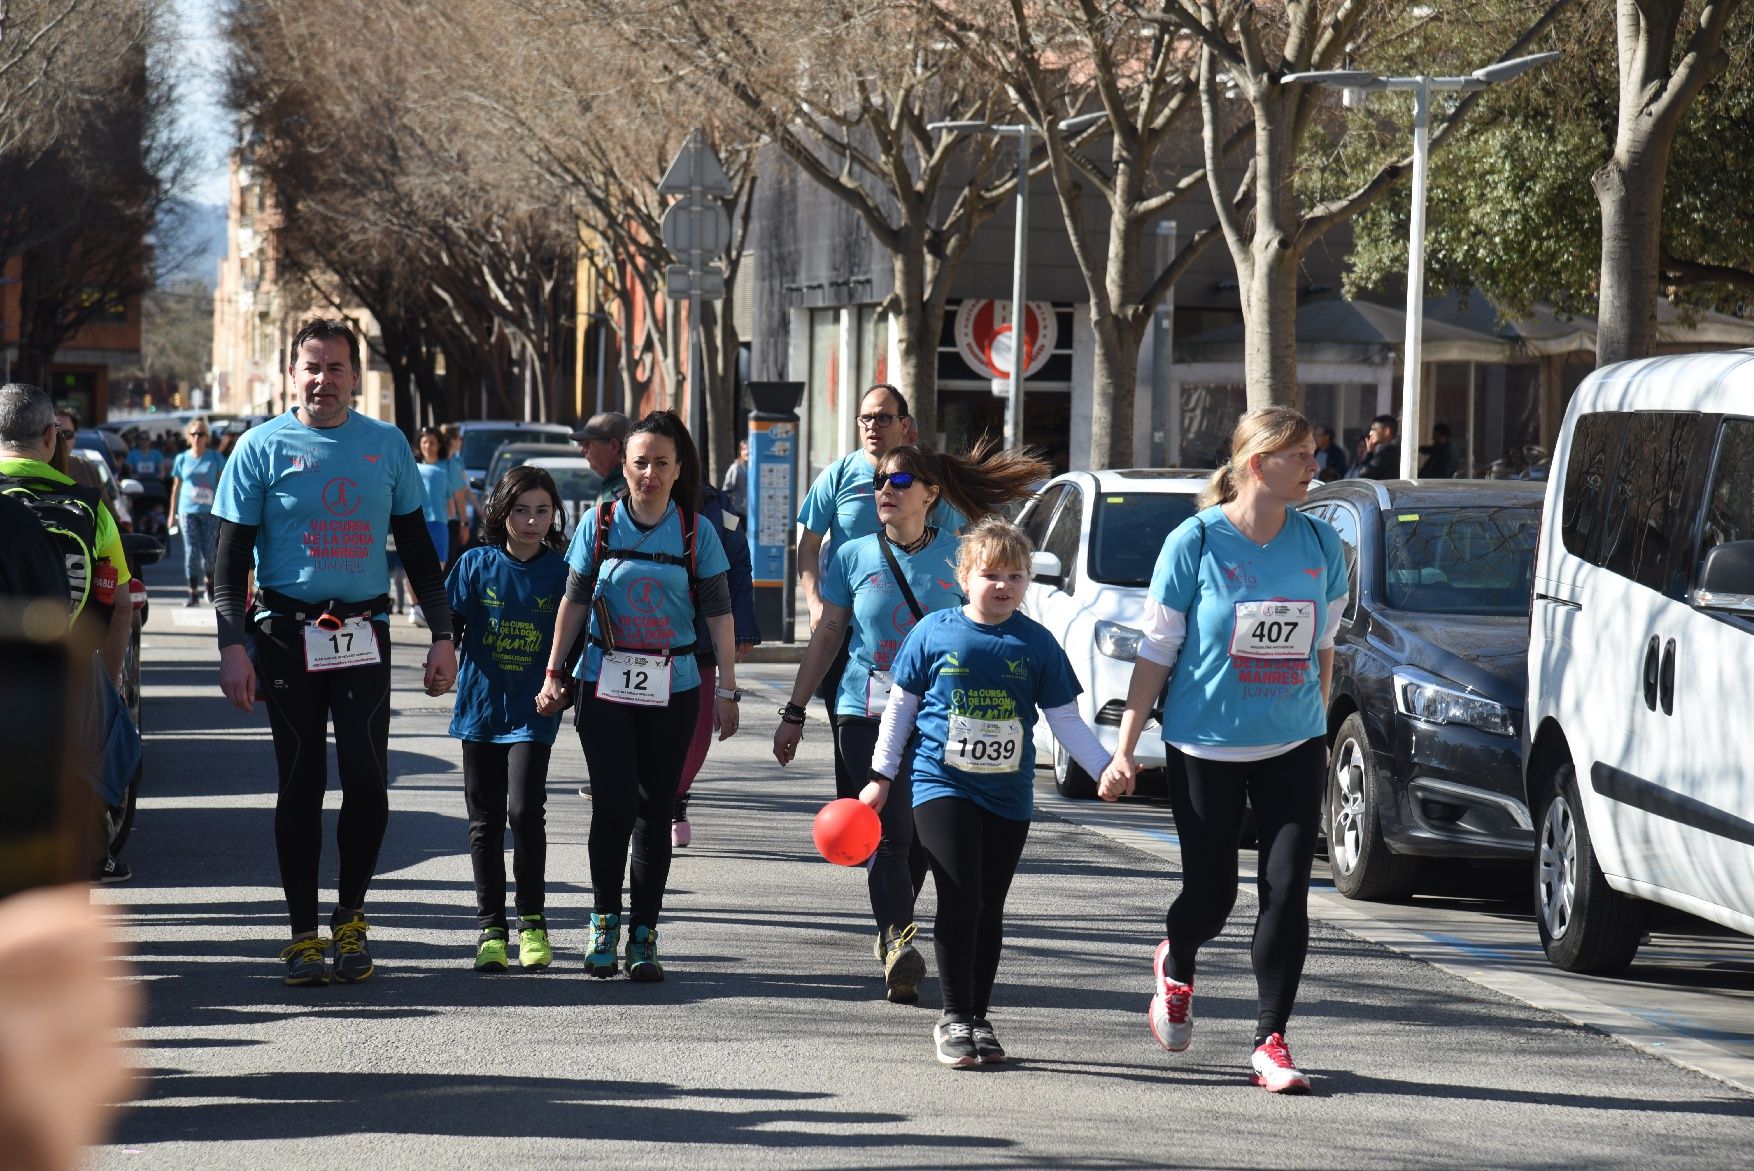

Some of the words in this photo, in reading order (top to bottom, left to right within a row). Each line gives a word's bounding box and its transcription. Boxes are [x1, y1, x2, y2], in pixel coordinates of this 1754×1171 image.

[331, 520, 371, 532] CURSA
[303, 532, 320, 545] DE
[323, 533, 340, 545] LA
[342, 533, 374, 545] DONA
[310, 547, 369, 559] MANRESA
[510, 620, 535, 630] CURSA
[511, 627, 520, 636] LA
[1251, 621, 1299, 643] 407
[329, 633, 353, 653] 17
[623, 669, 649, 691] 12
[1238, 671, 1304, 685] MANRESA
[979, 689, 1008, 698] CURSA
[968, 698, 980, 706] DE
[981, 698, 992, 706] LA
[957, 737, 1016, 761] 1039
